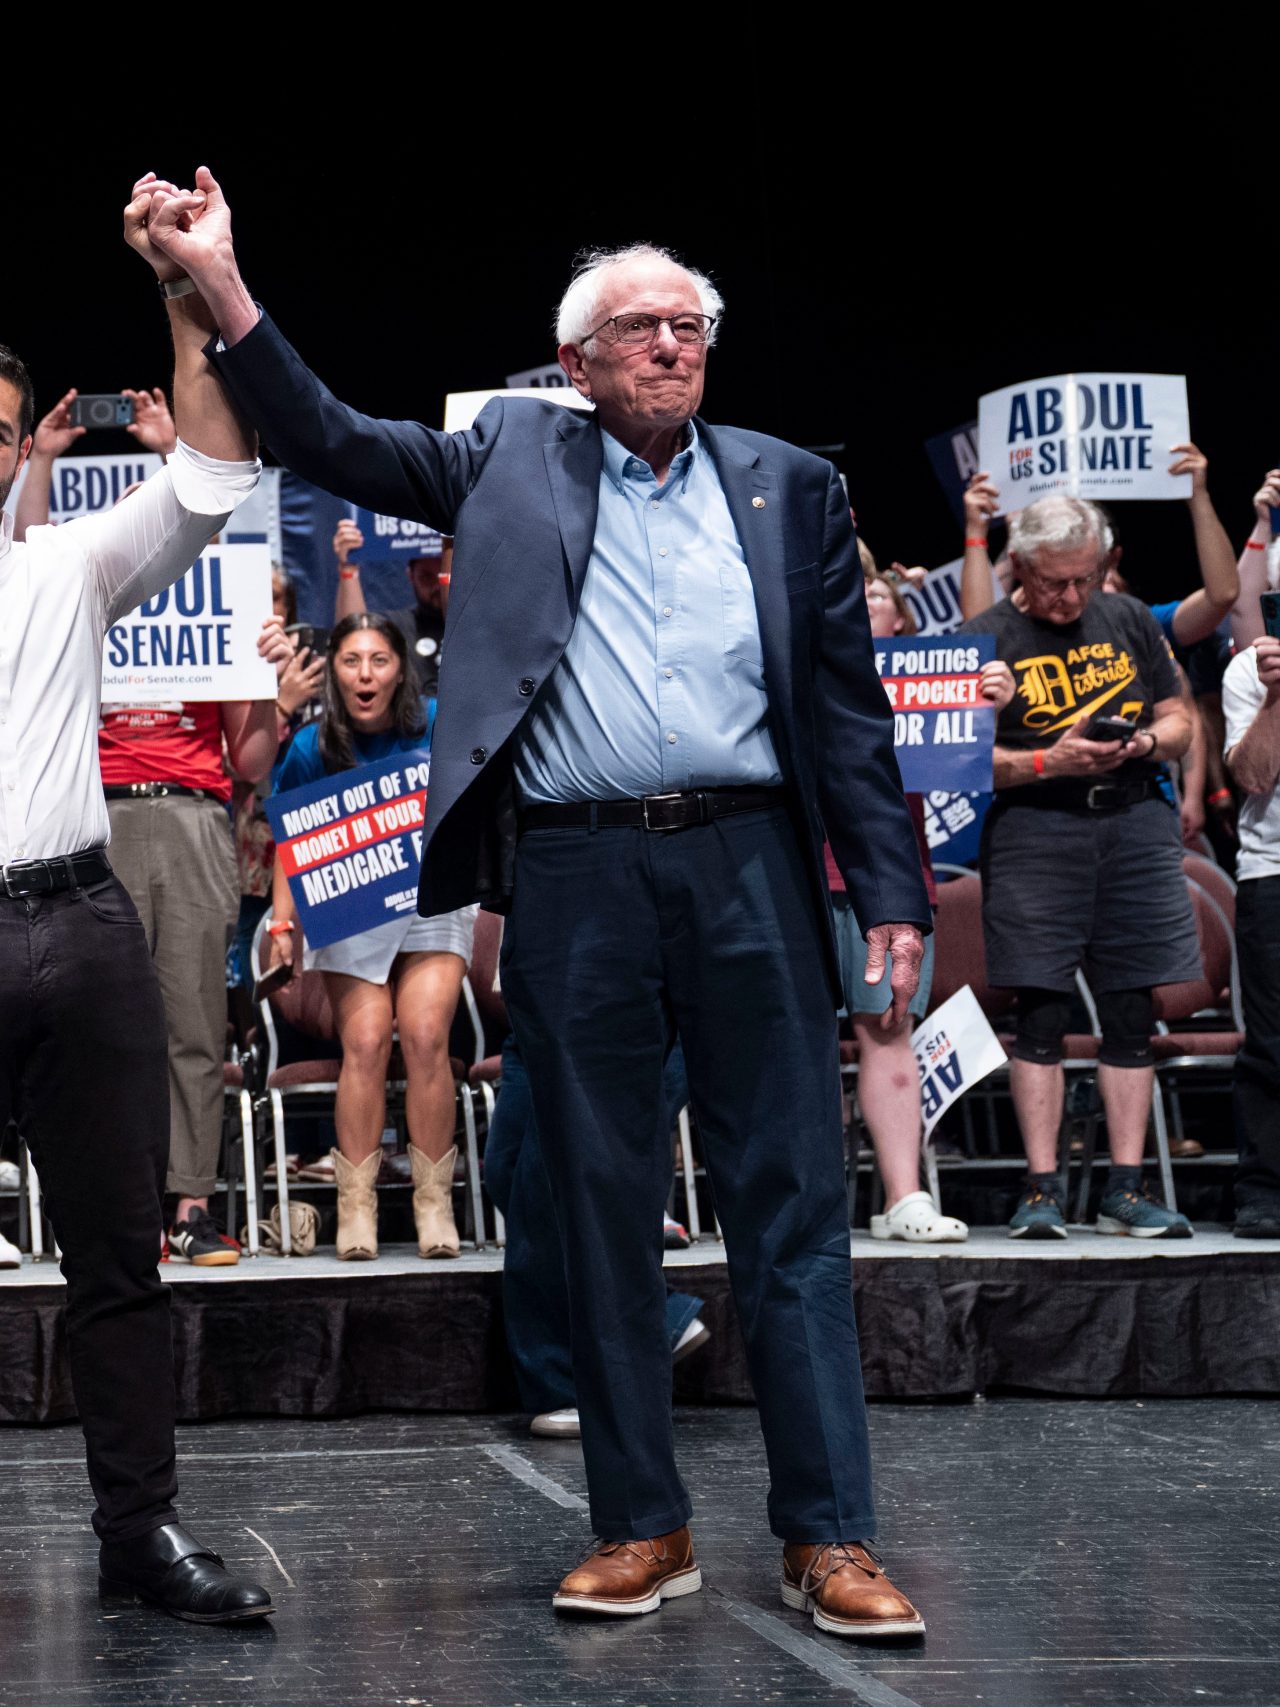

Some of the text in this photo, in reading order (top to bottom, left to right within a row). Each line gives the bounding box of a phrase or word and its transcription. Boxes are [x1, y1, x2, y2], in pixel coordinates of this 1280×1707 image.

[1008, 384, 1153, 444] ABDUL
[1010, 460, 1033, 481] US
[108, 623, 233, 668] SENATE
[892, 646, 980, 675] POLITICS
[1067, 642, 1115, 665] AFGE
[102, 673, 213, 685] bdulForSenate.com
[904, 678, 979, 706] POCKET
[1014, 651, 1137, 728] District
[894, 711, 978, 747] OR ALL
[282, 794, 341, 837] MONEY
[342, 780, 376, 813] OUT
[379, 771, 402, 800] OF
[291, 798, 424, 868] MONEY IN YOUR
[301, 837, 409, 907] MEDICARE
[925, 1029, 947, 1056] US
